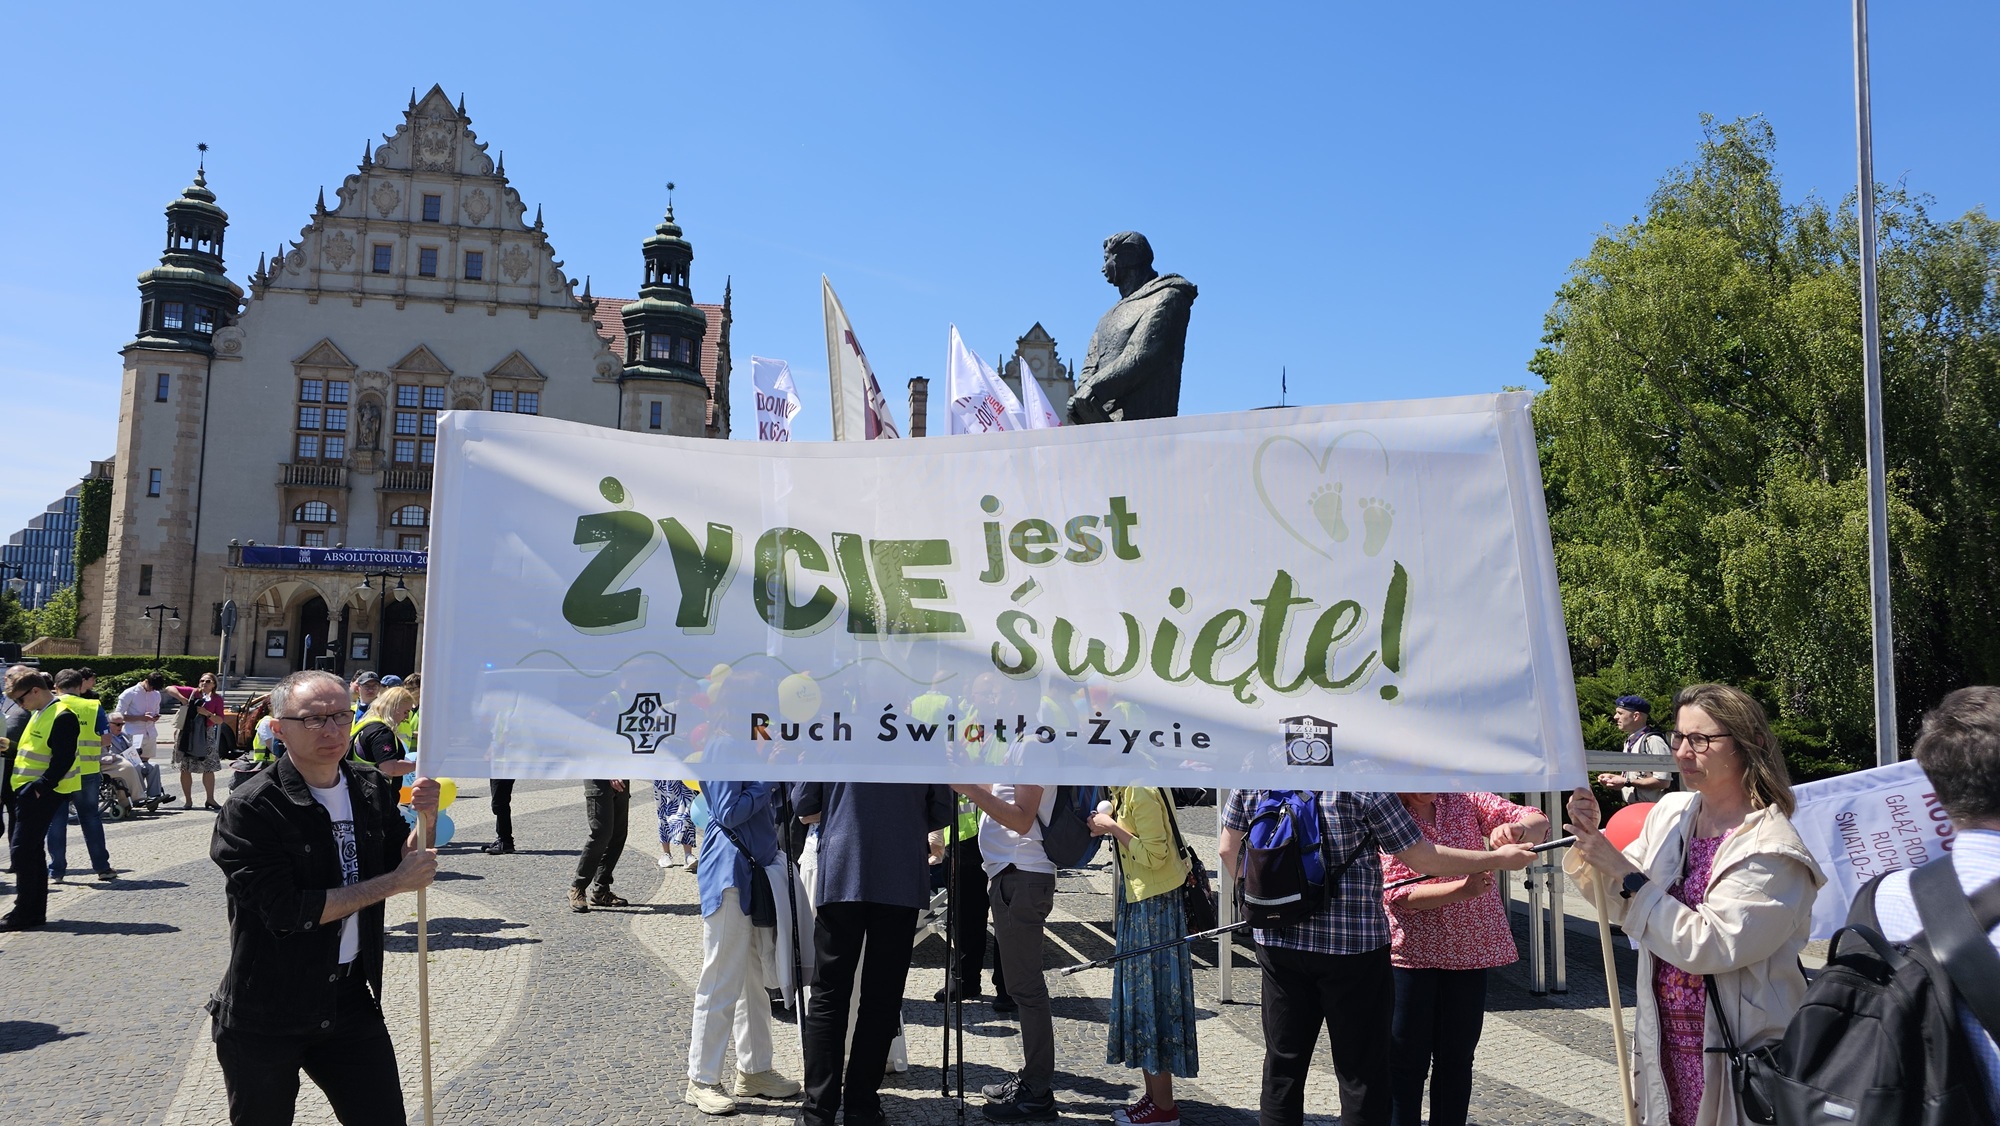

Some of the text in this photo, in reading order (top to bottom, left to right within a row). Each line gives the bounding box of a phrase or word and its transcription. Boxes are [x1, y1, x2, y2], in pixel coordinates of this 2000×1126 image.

[323, 552, 413, 564] ABSOLUTORIUM
[562, 476, 970, 636] ŻYCIE
[979, 495, 1143, 584] jest
[992, 560, 1411, 706] święte!
[750, 703, 1212, 754] Ruch Światło-Życie
[1835, 811, 1880, 885] ŚWIATŁO-Ż
[1885, 794, 1930, 869] GAŁĄŹ ROD
